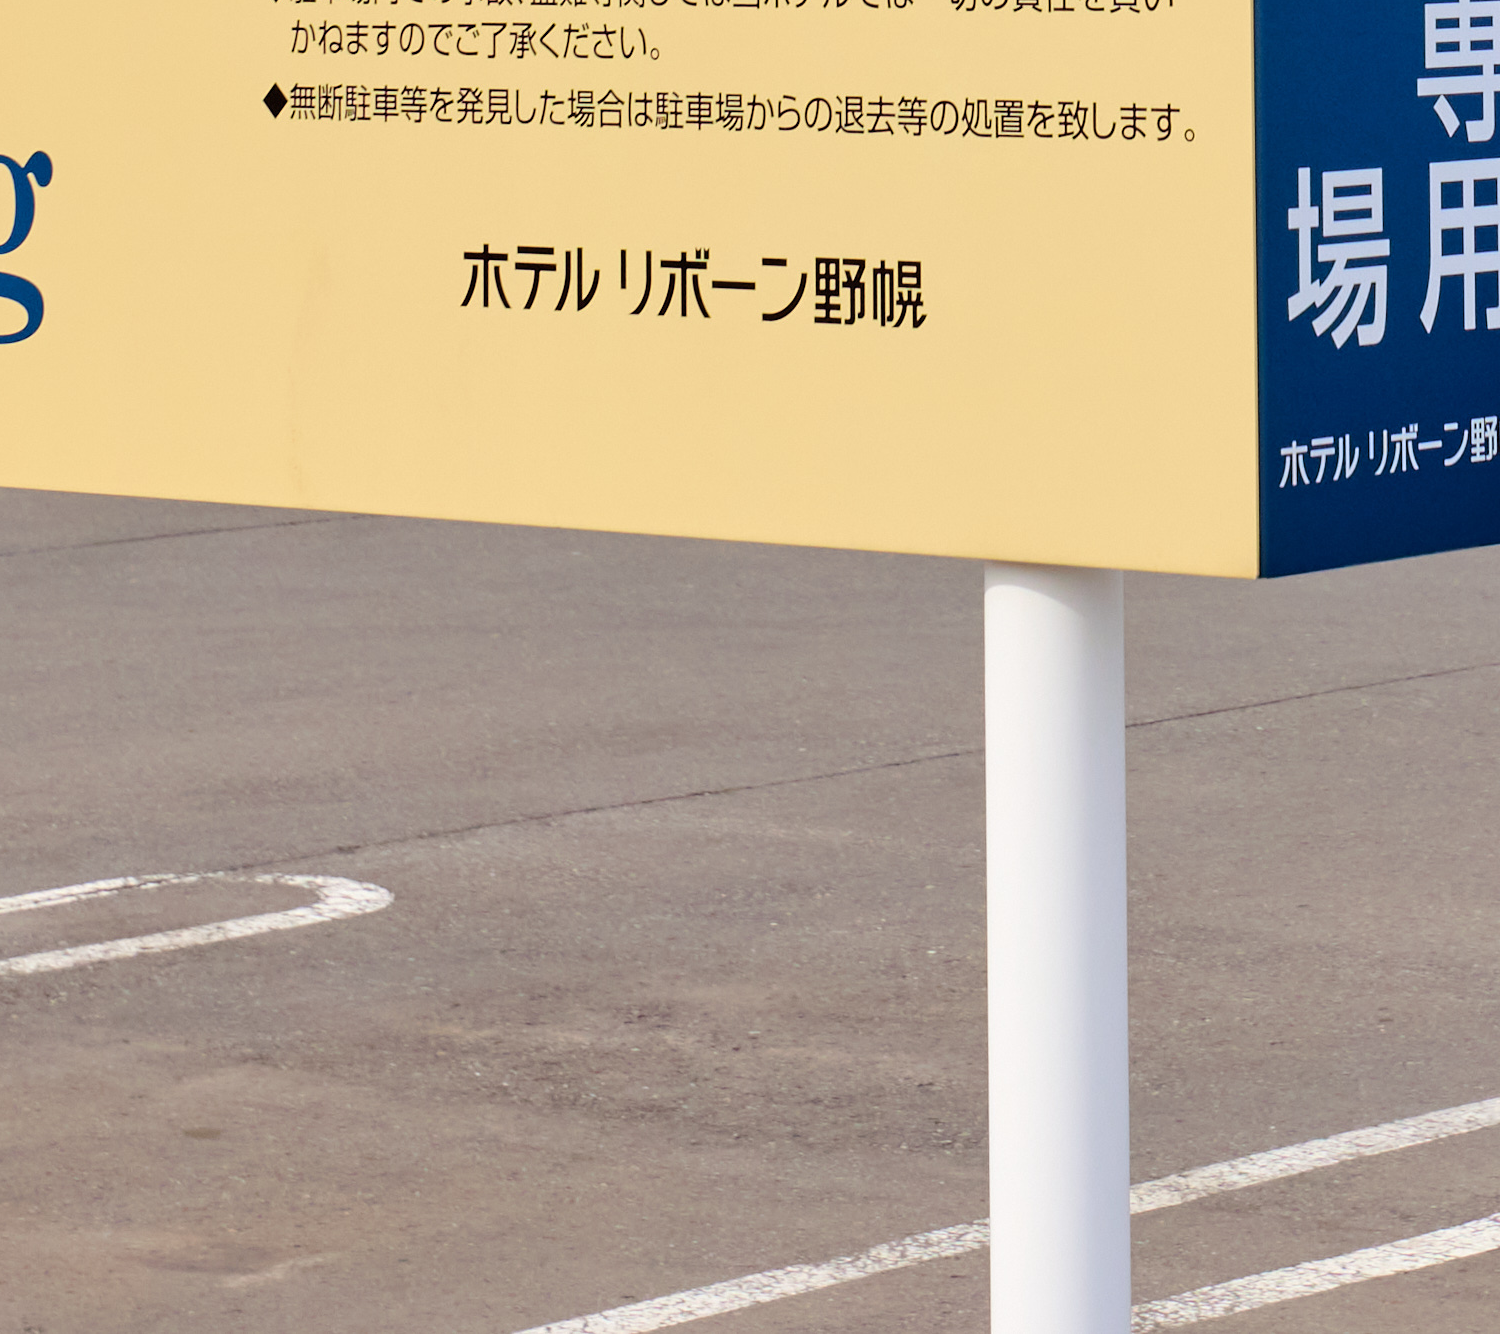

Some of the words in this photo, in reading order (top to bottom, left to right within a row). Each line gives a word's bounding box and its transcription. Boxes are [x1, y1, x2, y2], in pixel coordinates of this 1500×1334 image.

[290, 19, 661, 62] かねますのでご了承ください。
[288, 82, 1196, 143] 無断駐車等を発見した場合は駐車場からの退去等の処置を致します。
[459, 242, 602, 313] ホテル
[619, 246, 929, 330] リボーン野幌
[1278, 432, 1360, 489] ホテル
